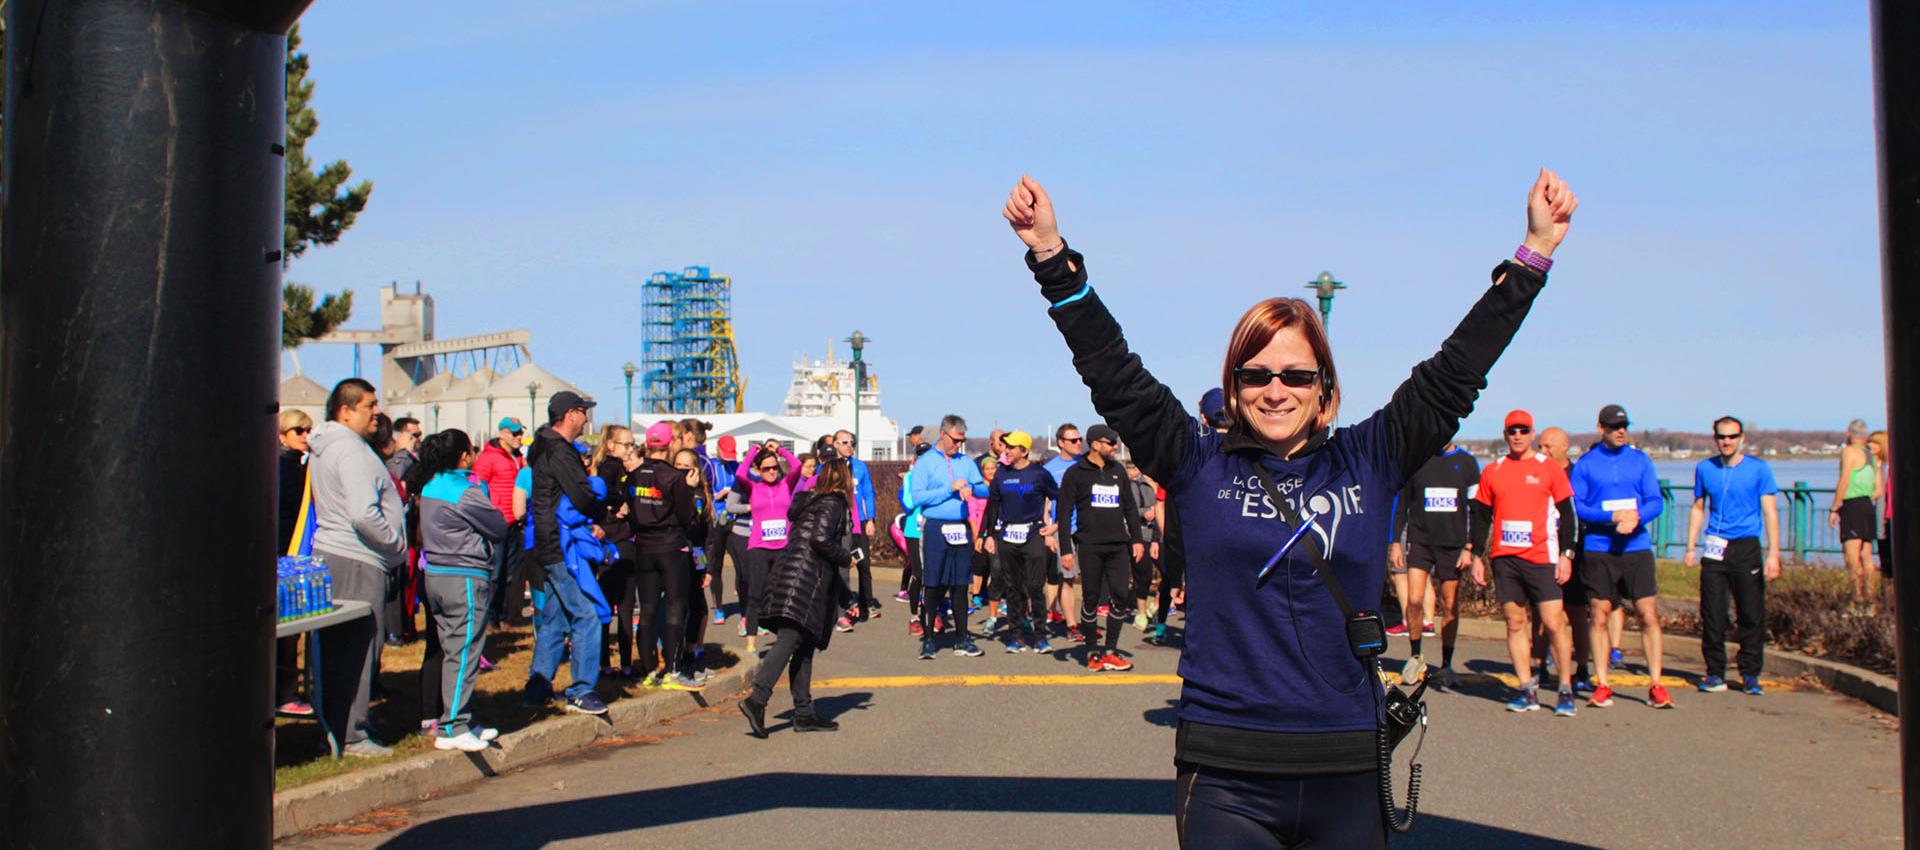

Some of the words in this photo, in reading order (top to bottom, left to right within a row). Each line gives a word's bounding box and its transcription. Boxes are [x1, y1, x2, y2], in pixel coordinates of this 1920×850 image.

[1247, 475, 1304, 496] CRSE
[1094, 493, 1117, 505] 1051
[1217, 489, 1232, 500] DE
[1427, 496, 1456, 508] 1043
[1502, 530, 1531, 543] 1005
